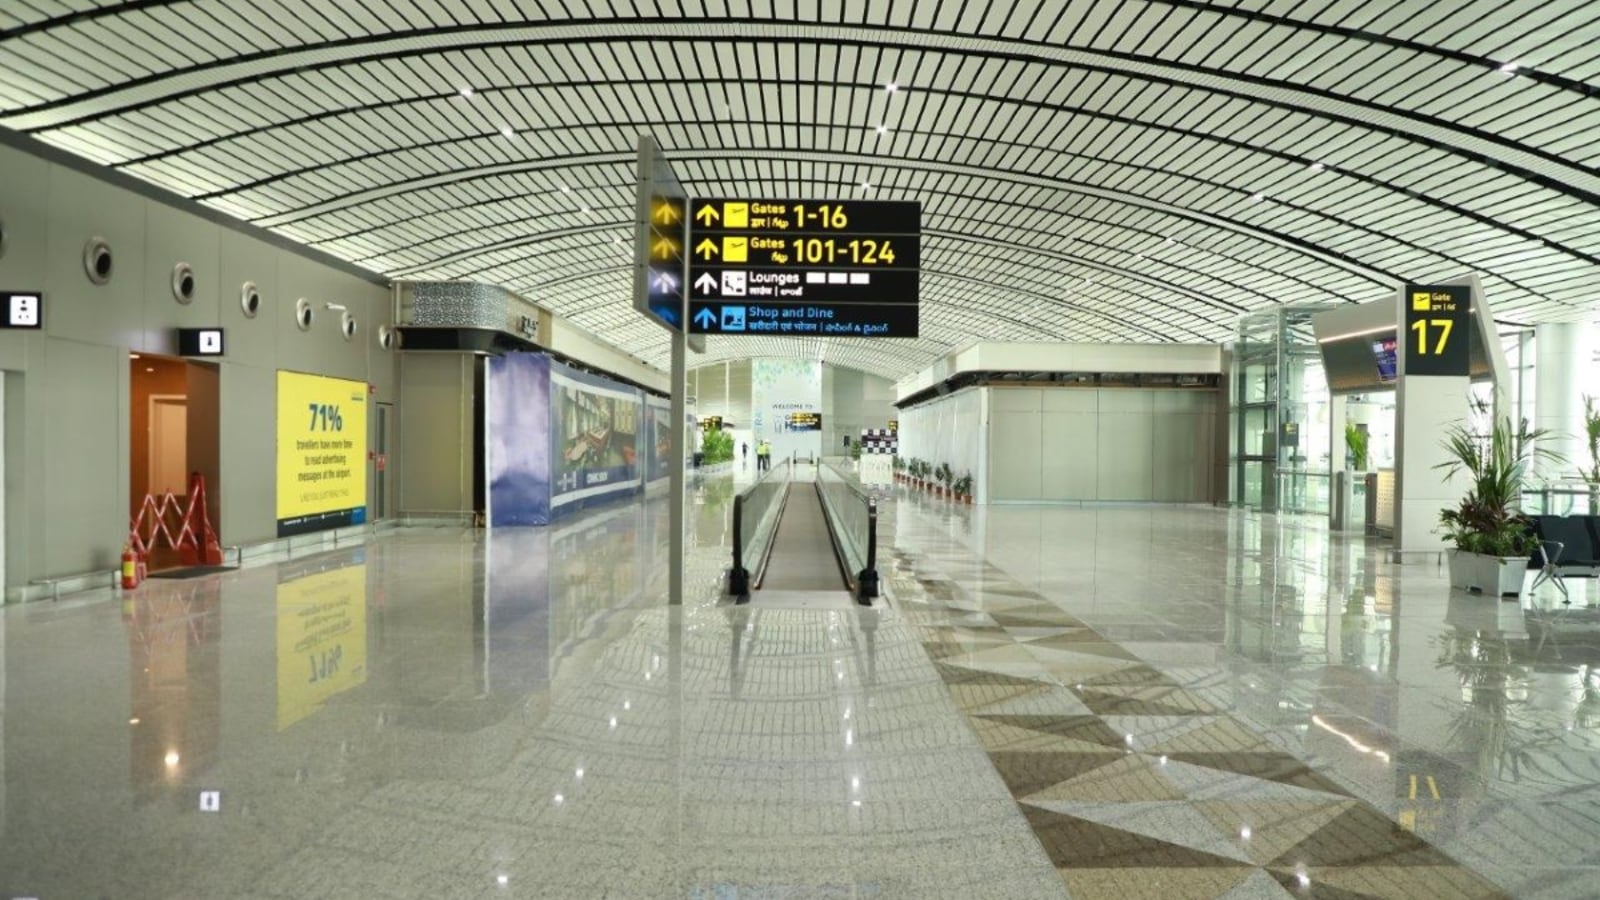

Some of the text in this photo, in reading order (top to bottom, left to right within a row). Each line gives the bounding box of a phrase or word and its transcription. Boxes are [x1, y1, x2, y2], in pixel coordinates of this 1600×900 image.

[751, 203, 848, 228] Gates 1-16
[750, 237, 896, 264] Gates 101-124
[749, 271, 799, 286] Lounges
[1432, 292, 1451, 301] Gate
[749, 306, 833, 319] Shop and Dine
[1411, 319, 1453, 354] 17
[309, 403, 342, 432] 71%
